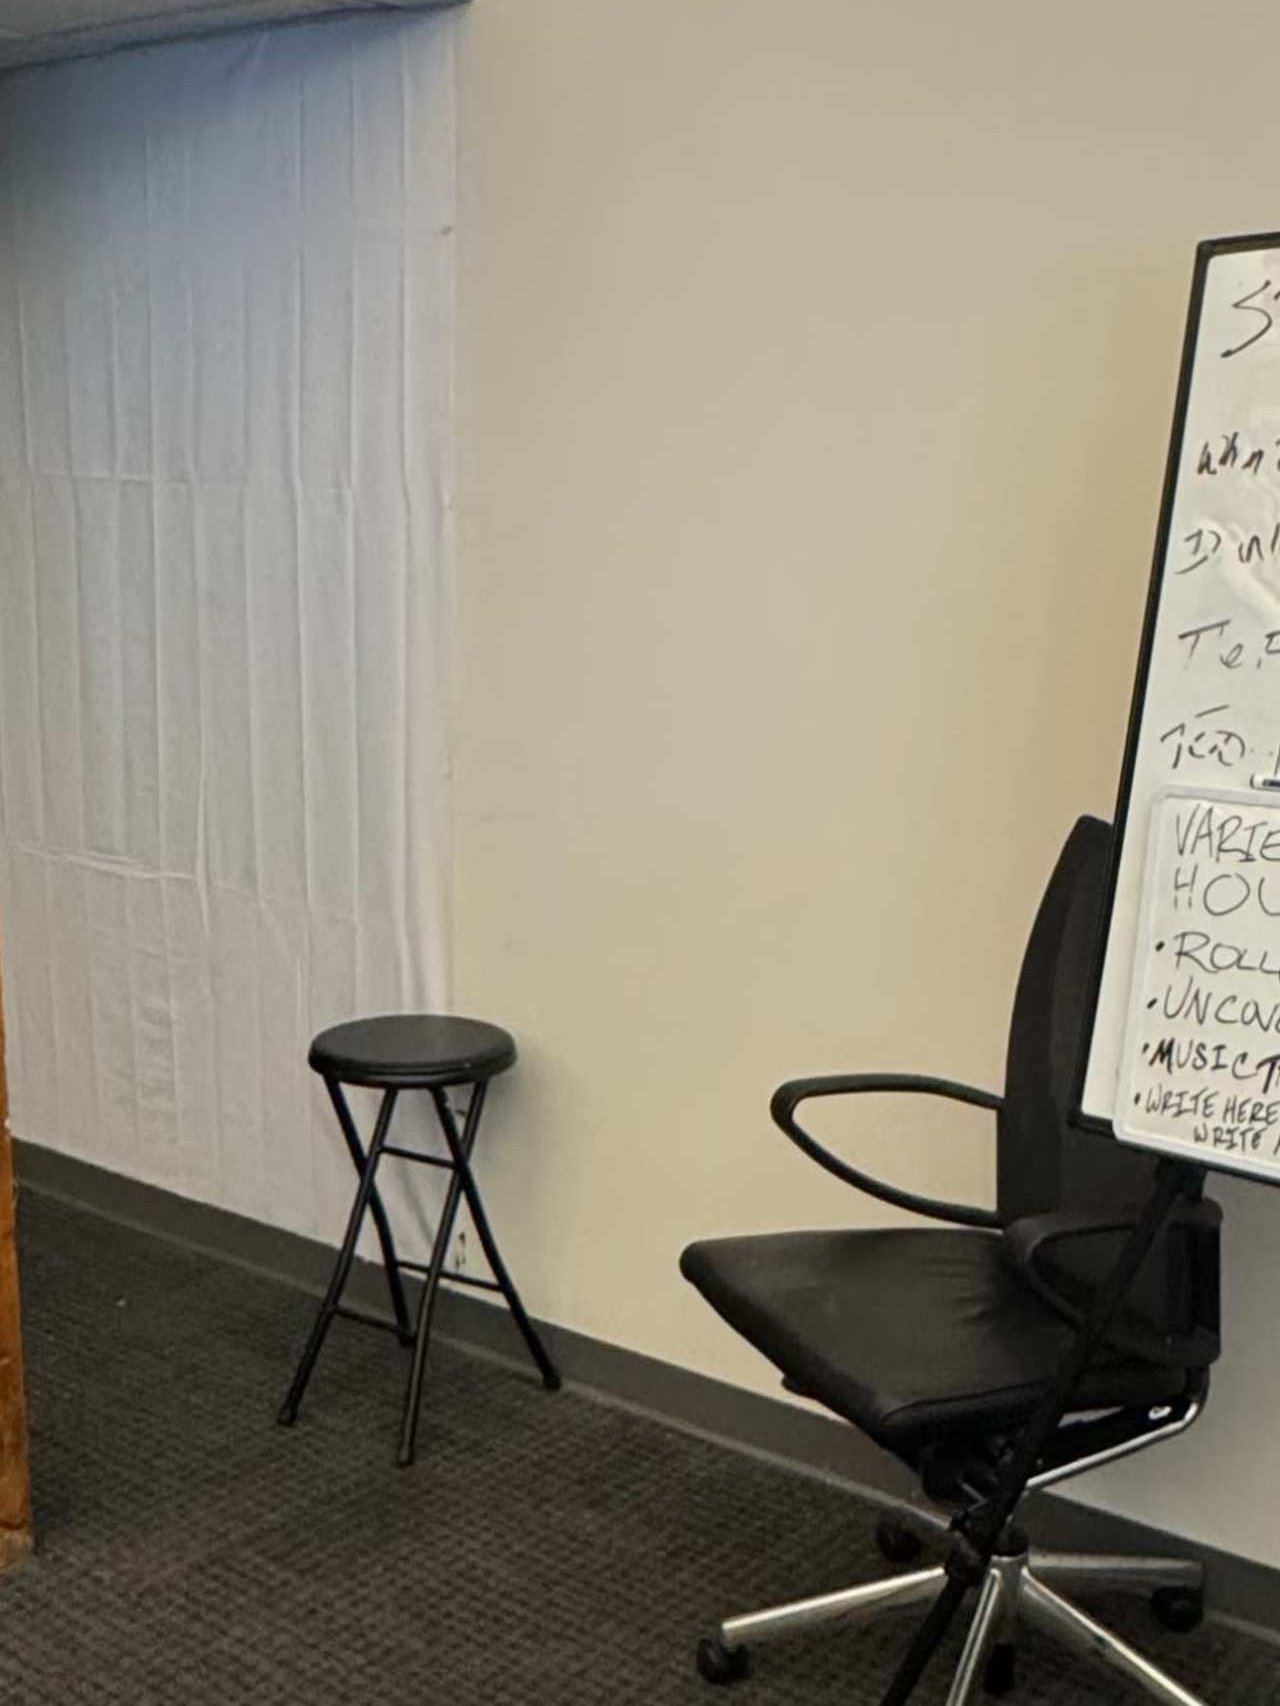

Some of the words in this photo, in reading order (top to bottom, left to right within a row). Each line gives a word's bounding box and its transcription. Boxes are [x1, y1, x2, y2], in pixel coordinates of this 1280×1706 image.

[1148, 1041, 1252, 1081] MUSIC
[1145, 1085, 1218, 1119] WRITE
[1192, 1121, 1268, 1152] WRITE
